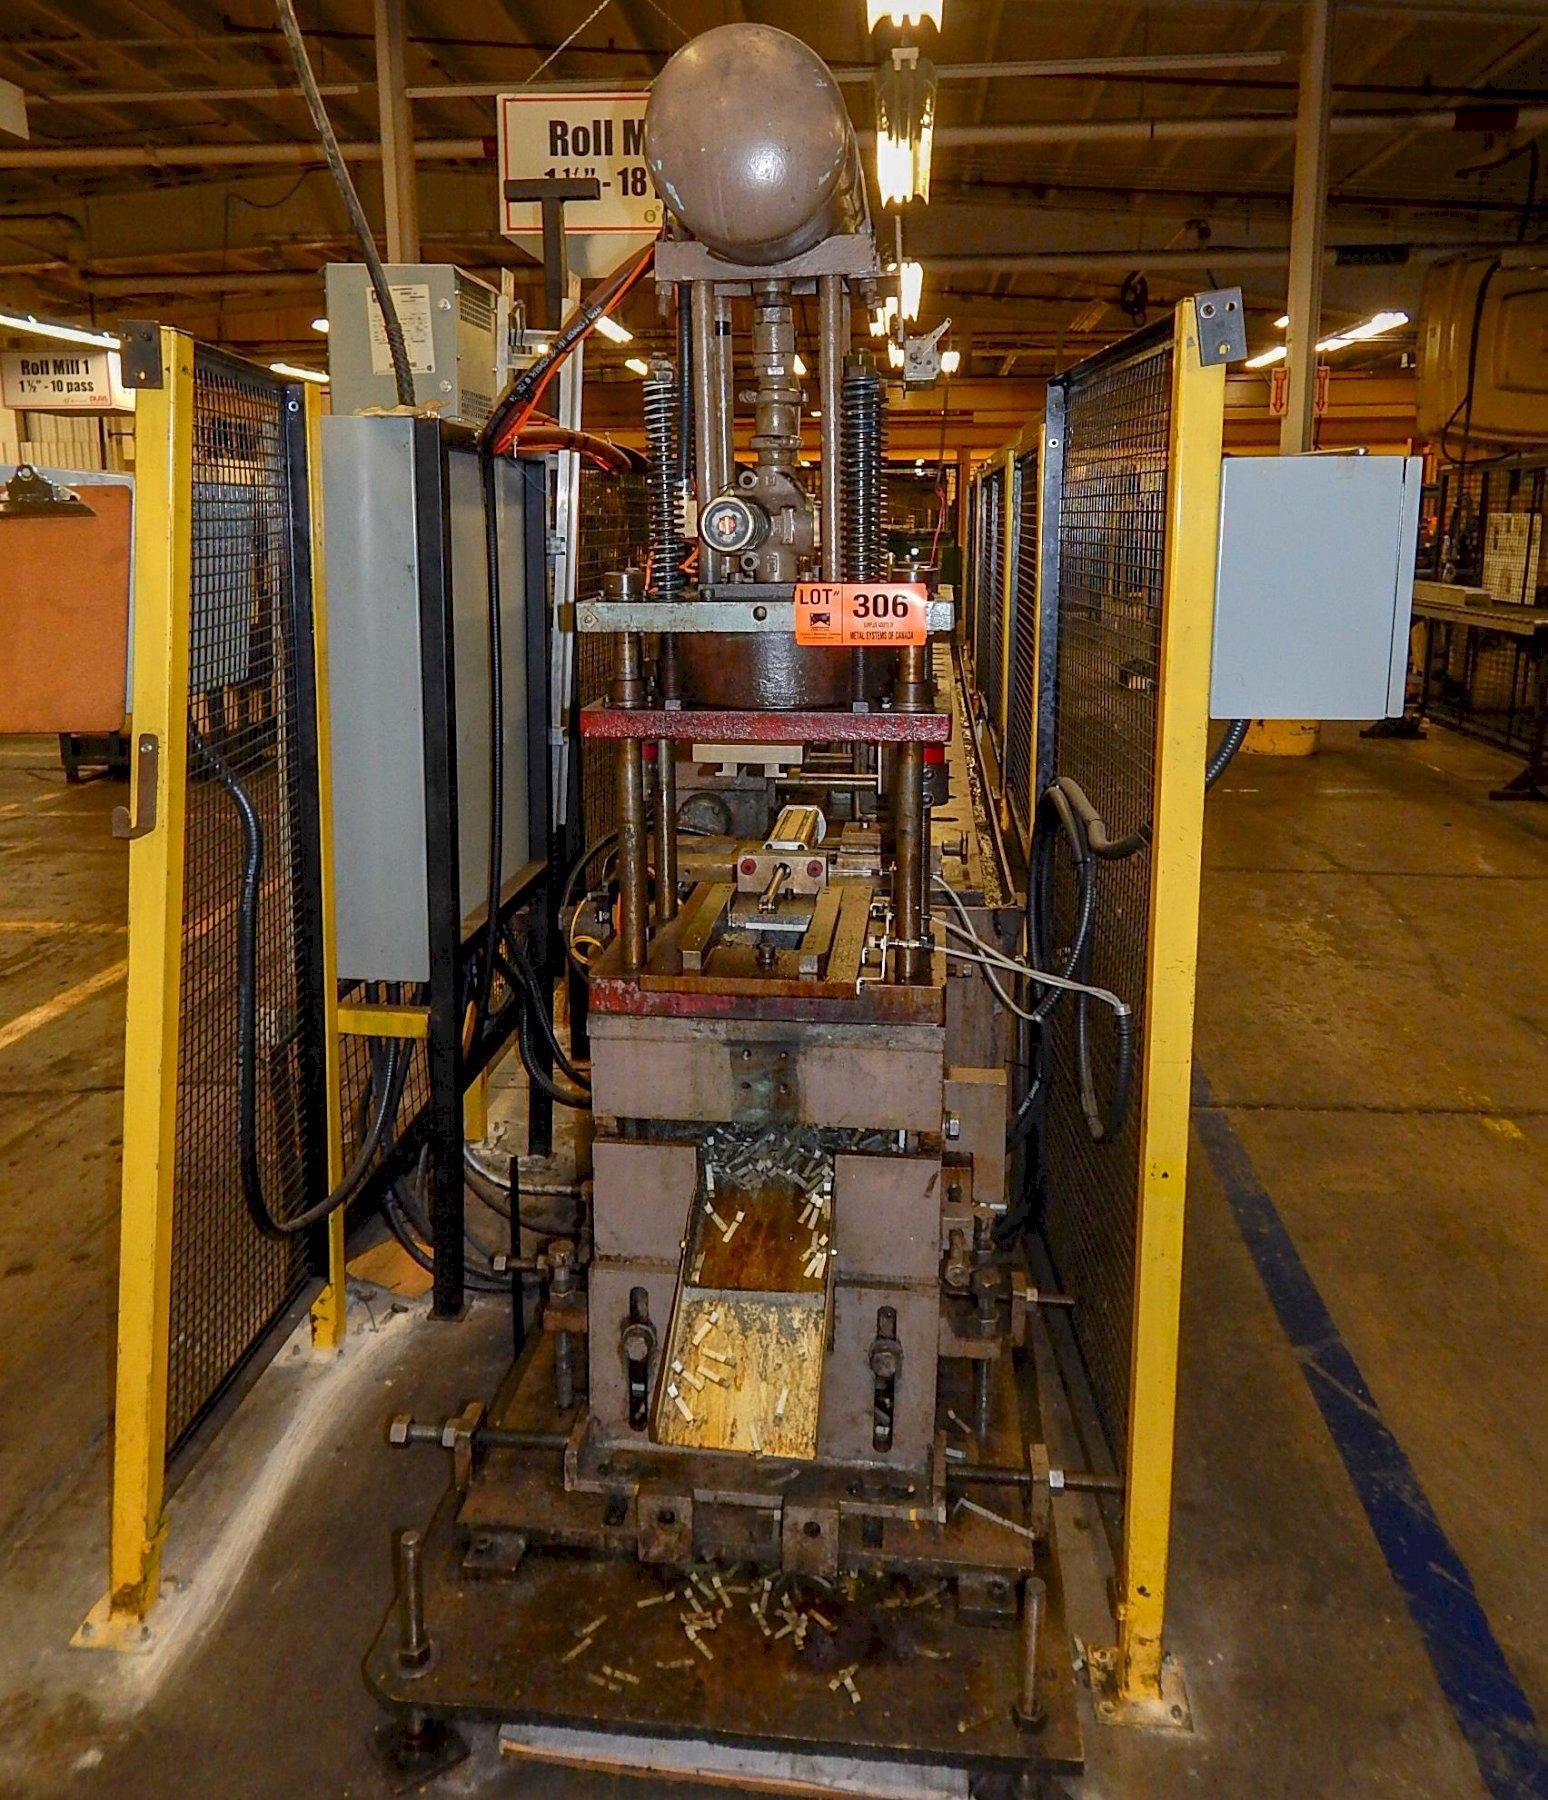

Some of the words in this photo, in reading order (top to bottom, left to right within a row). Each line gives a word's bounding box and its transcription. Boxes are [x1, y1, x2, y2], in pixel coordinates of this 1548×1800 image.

[549, 119, 613, 156] Roll
[617, 167, 647, 196] 18
[21, 359, 49, 375] Roll
[53, 359, 80, 375] Mill
[82, 359, 90, 375] 1
[50, 380, 64, 392] 10
[66, 381, 94, 393] pass
[853, 594, 909, 618] 306
[850, 631, 864, 640] METAL
[866, 631, 887, 640] SYSTEMS
[888, 631, 895, 640] OF
[896, 631, 914, 640] CANADA
